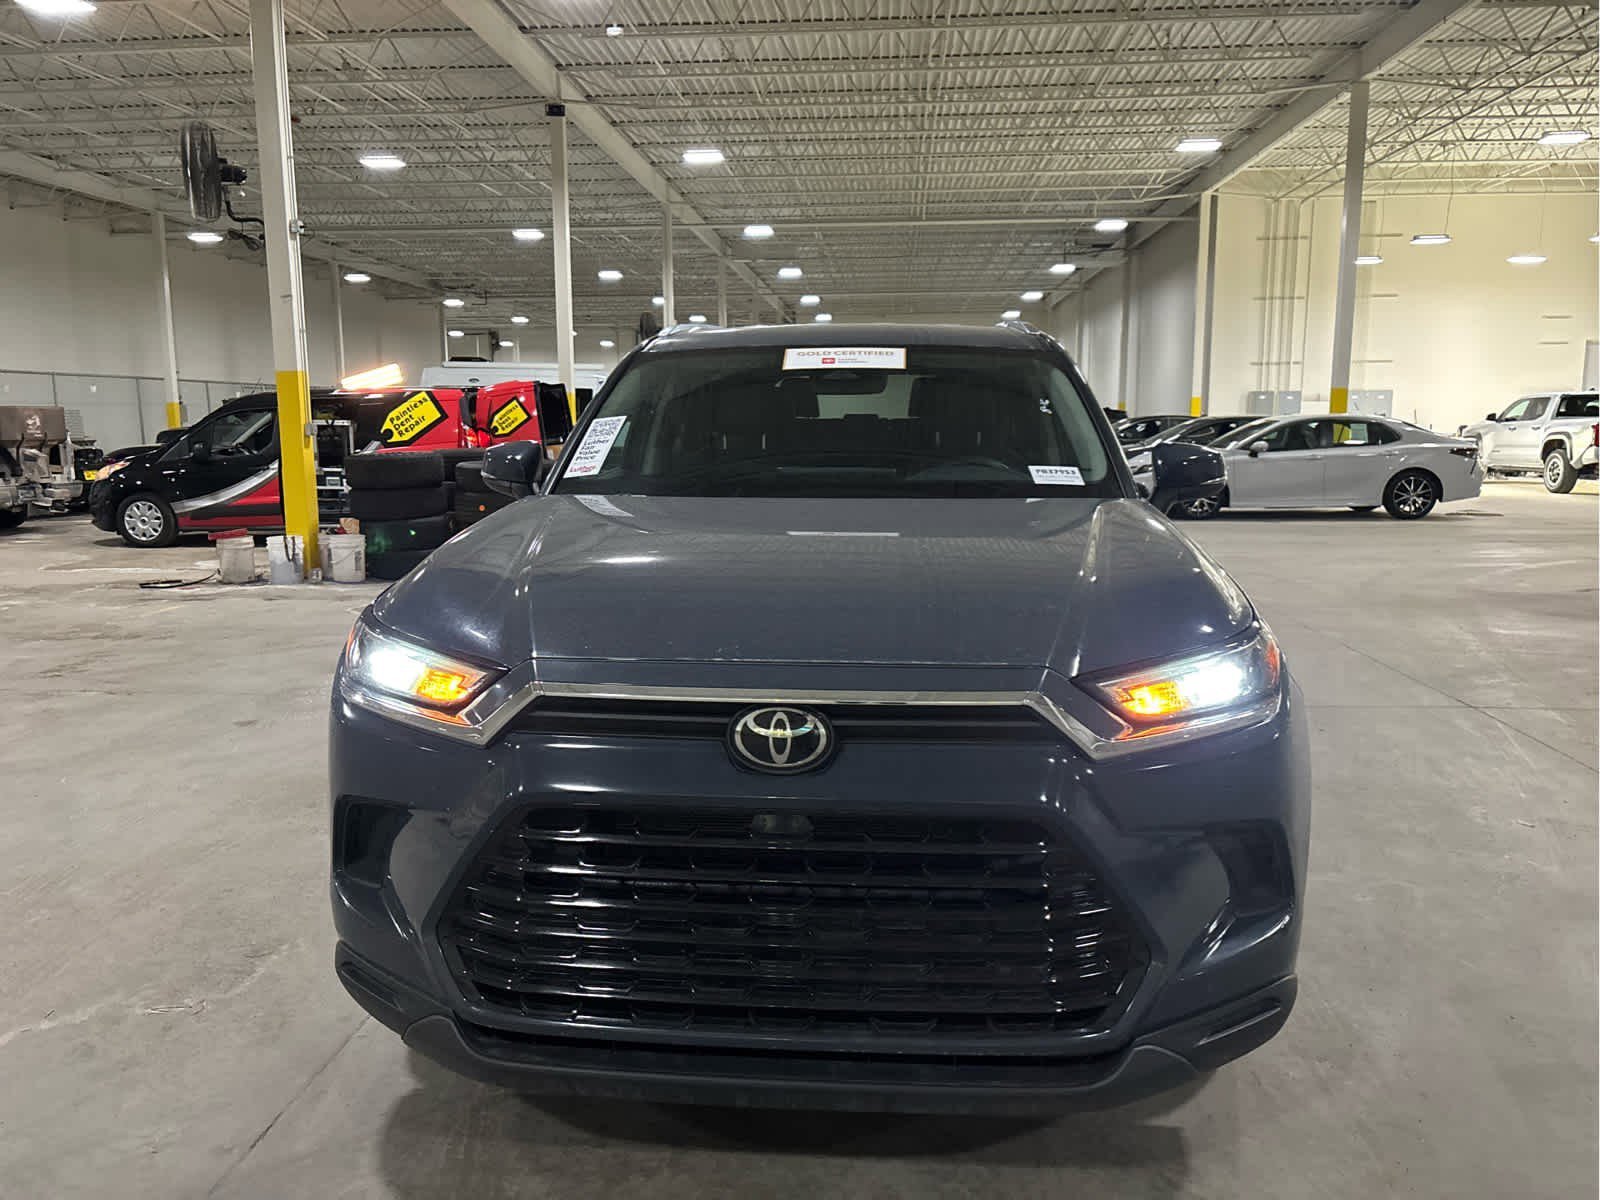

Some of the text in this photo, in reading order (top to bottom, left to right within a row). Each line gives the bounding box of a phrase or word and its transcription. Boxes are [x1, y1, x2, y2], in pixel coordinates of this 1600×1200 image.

[389, 397, 428, 424] Paintless
[394, 414, 414, 431] Dent
[398, 415, 425, 437] Repair
